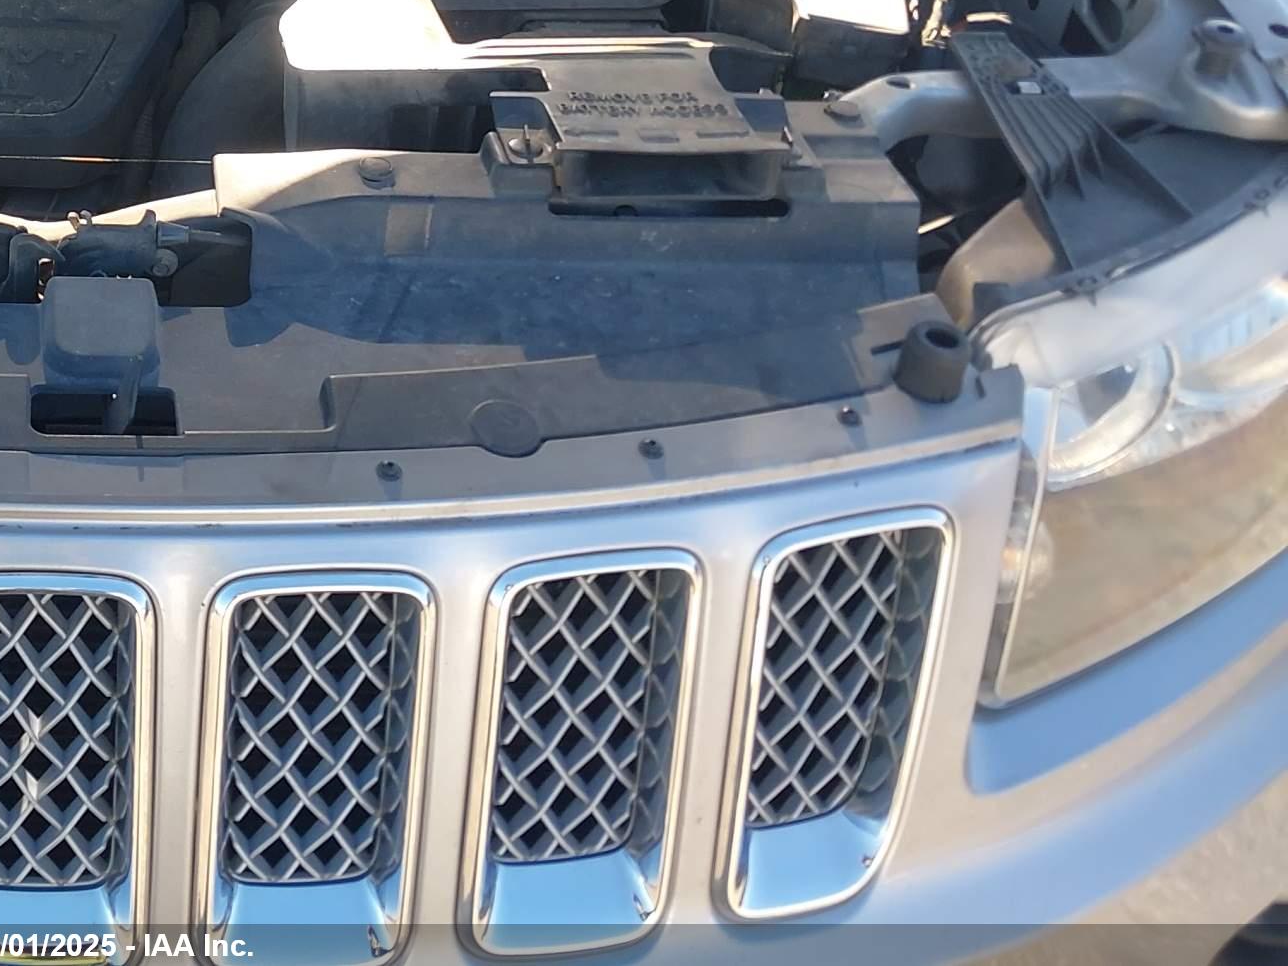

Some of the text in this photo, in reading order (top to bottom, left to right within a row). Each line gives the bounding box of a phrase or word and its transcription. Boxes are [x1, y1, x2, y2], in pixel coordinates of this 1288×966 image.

[568, 91, 699, 104] REMOVE FOR
[558, 103, 729, 117] BATTERY ACCESS
